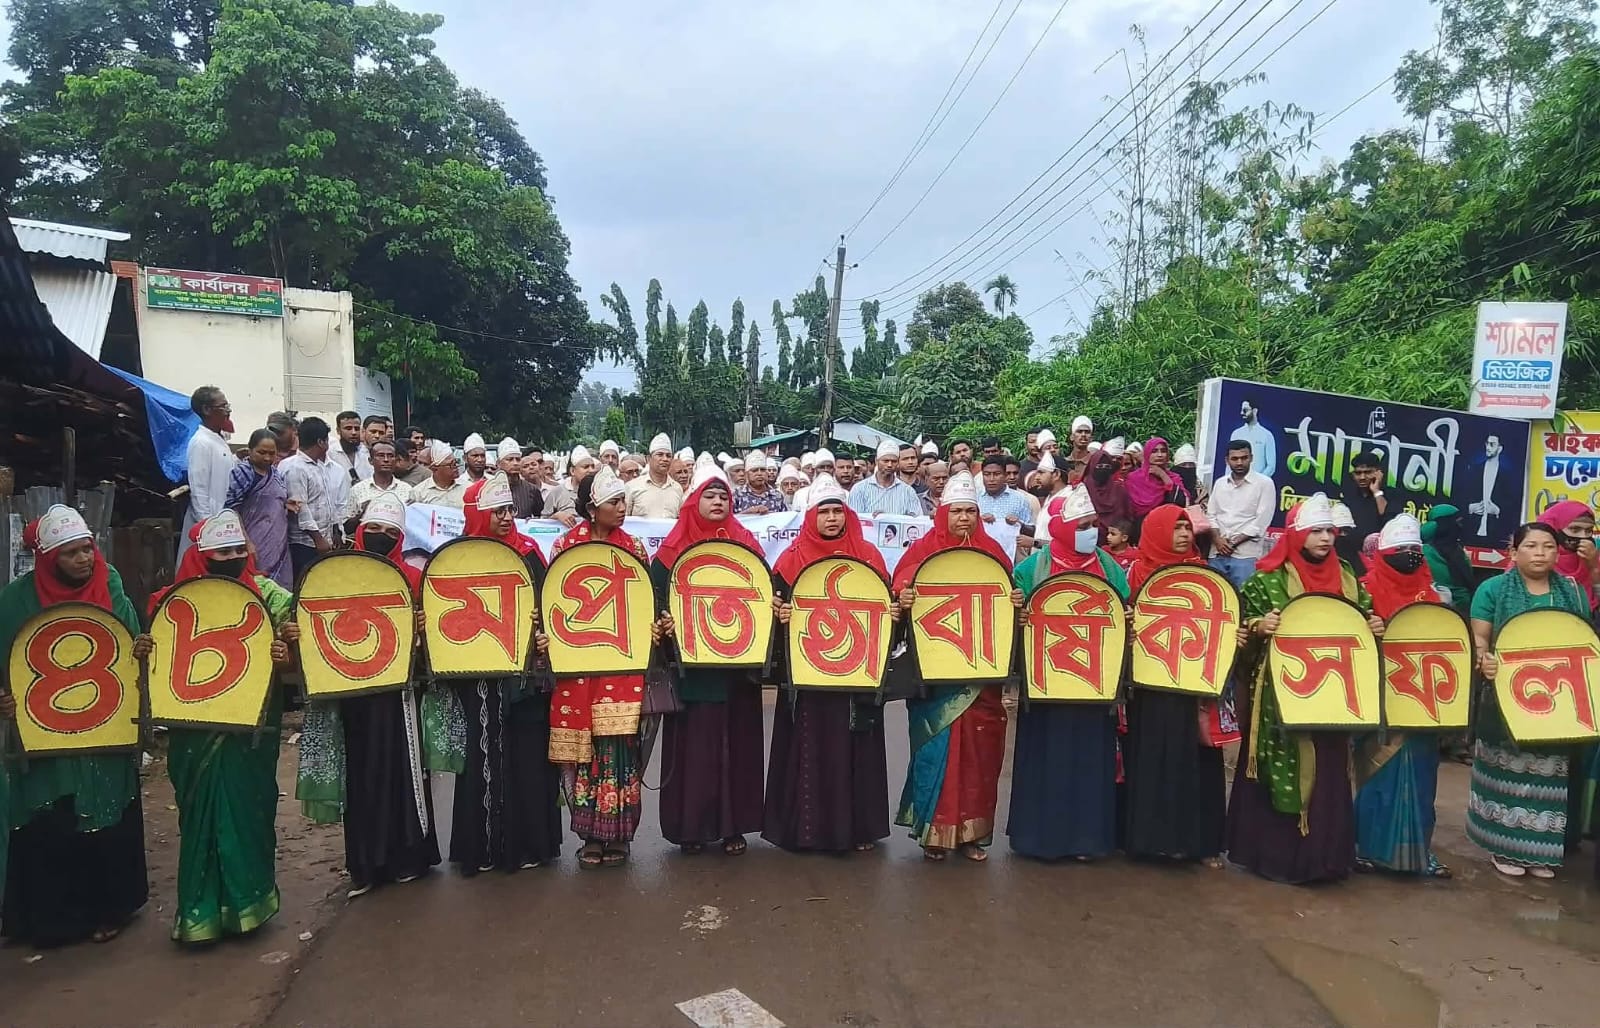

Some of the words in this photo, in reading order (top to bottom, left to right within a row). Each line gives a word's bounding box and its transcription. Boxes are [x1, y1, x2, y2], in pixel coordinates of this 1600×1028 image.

[182, 276, 251, 294] কার্যালয়
[1485, 322, 1560, 355] শ্যামল
[1485, 361, 1551, 380] মিউজিক
